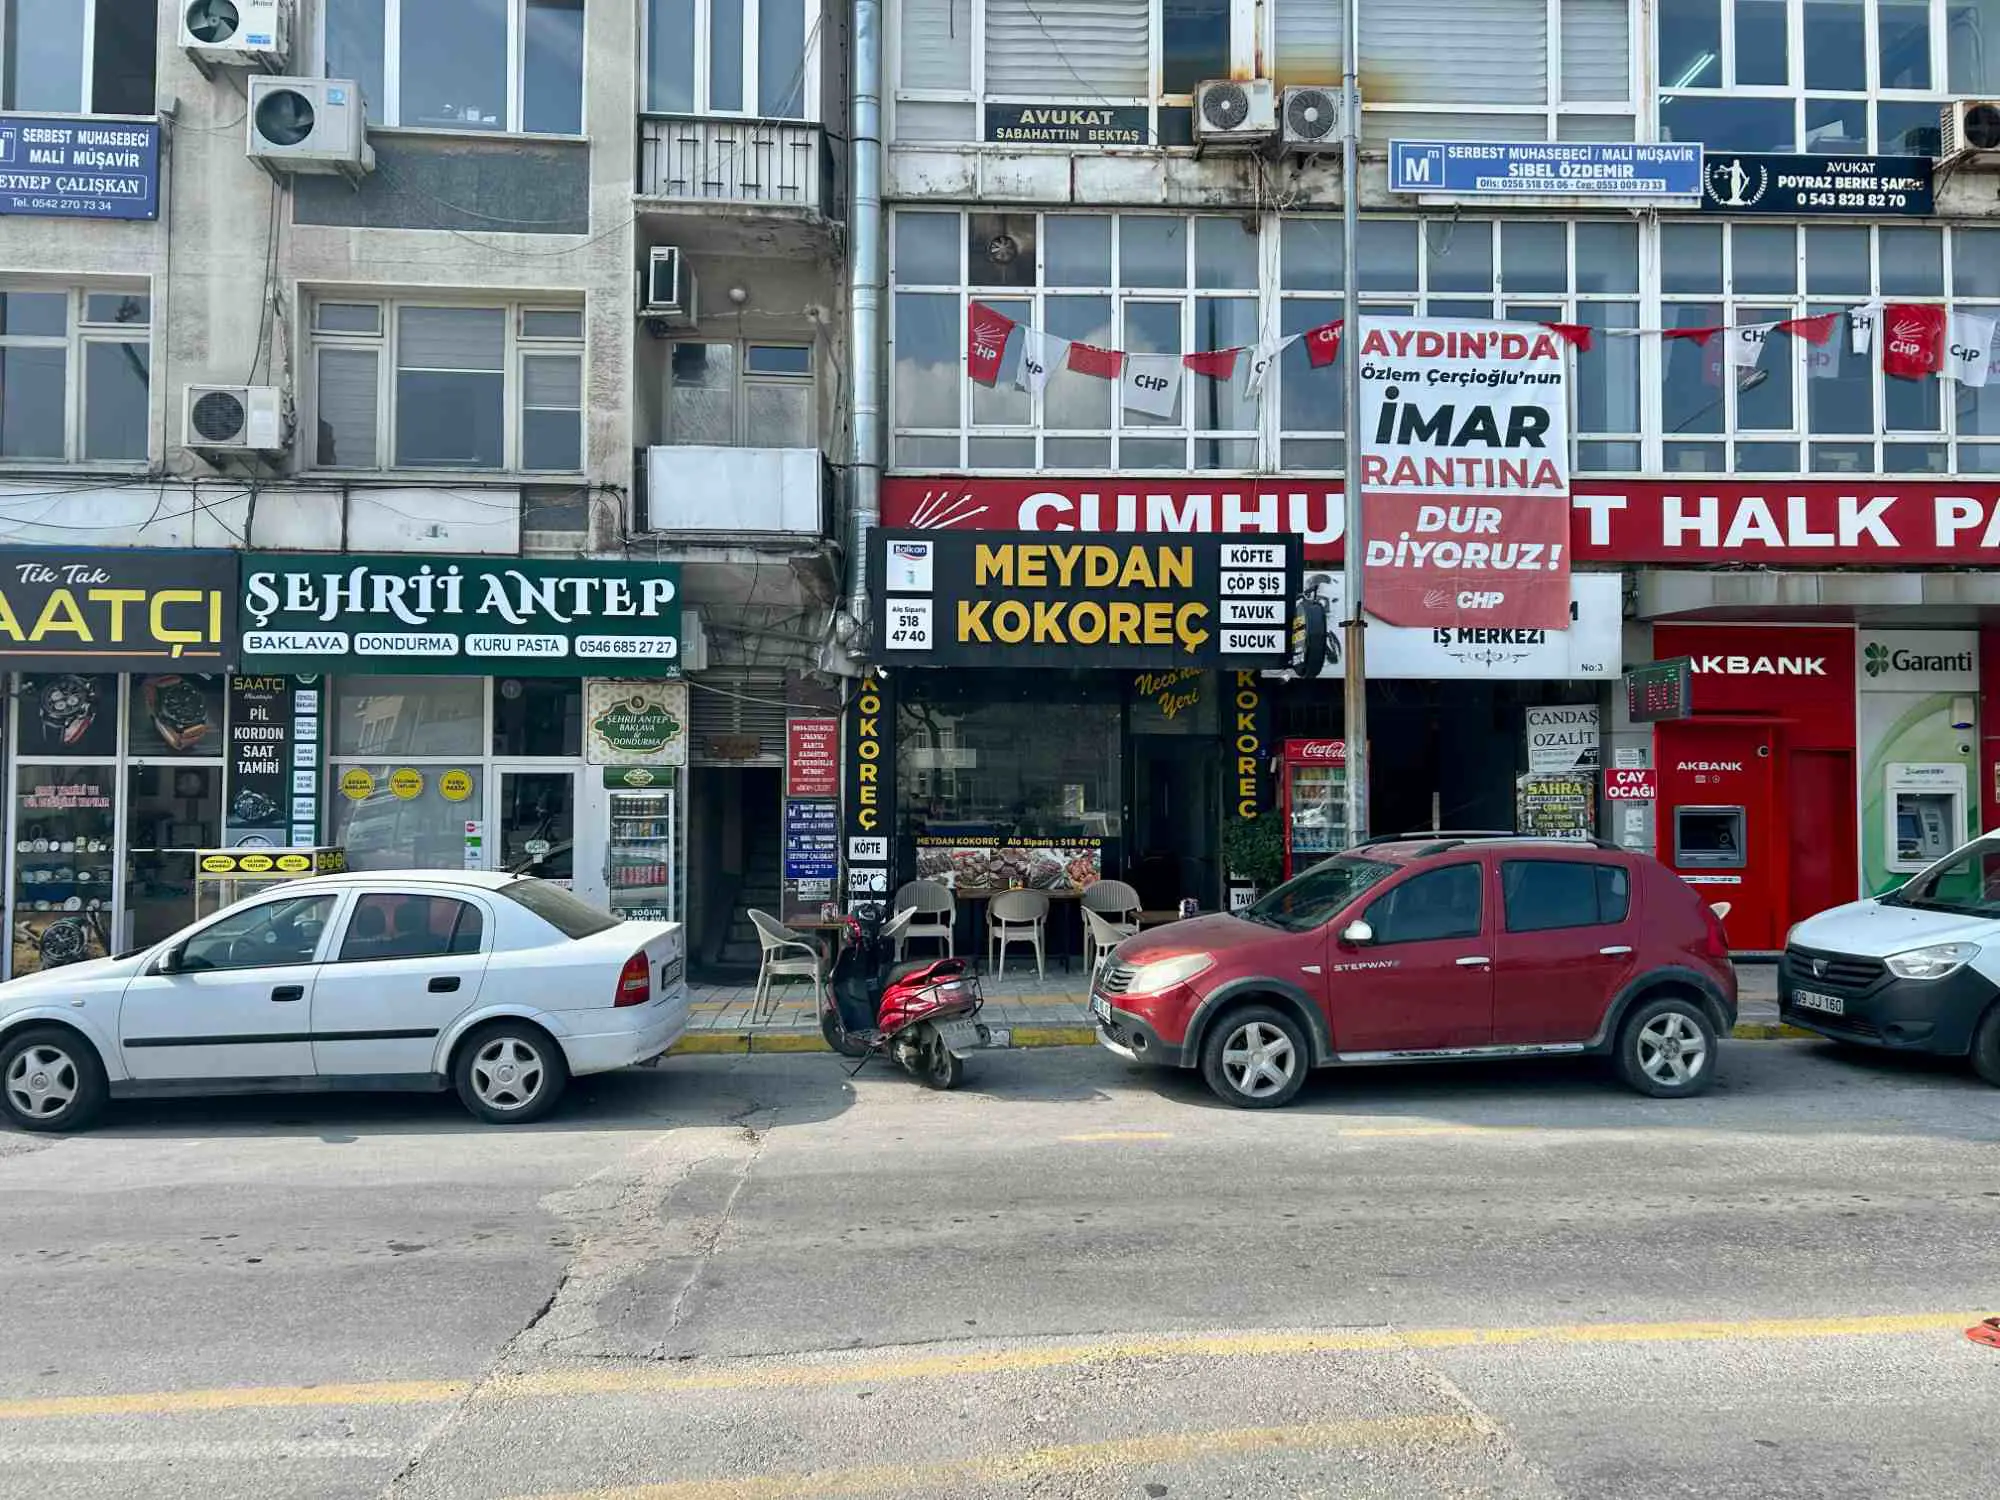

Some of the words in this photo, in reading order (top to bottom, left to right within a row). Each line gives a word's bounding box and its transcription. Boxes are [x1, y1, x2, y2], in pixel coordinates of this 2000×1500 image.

[1020, 109, 1114, 125] AVUKAT
[22, 127, 73, 145] SERBEST
[77, 129, 150, 148] MUHASEBECİ
[1088, 129, 1140, 145] BEKTAŞ
[29, 147, 65, 164] MALİ
[73, 148, 140, 170] MÜŞAVİR
[1448, 146, 1506, 160] SERBEST
[1509, 146, 1592, 161] MUHASEBECİ
[1602, 146, 1633, 161] MALİ
[1636, 146, 1694, 164] MÜŞAVİR
[1826, 162, 1876, 174] AVUKAT
[55, 176, 140, 196] ÇALIŞKAN
[1778, 175, 1833, 189] POYRAZ
[1835, 177, 1878, 190] BERKE
[32, 199, 58, 209] 0542
[60, 200, 81, 209] 270
[83, 201, 96, 210] 73
[99, 201, 112, 211] 34
[1797, 192, 1807, 206] 0
[1809, 193, 1836, 206] 543
[1838, 194, 1865, 207] 828
[1867, 194, 1886, 207] 82
[1887, 195, 1907, 208] 70
[1360, 329, 1560, 361] AYDIN'DA
[1889, 340, 1921, 355] CHP
[1134, 374, 1169, 392] CHP
[1361, 362, 1421, 382] Özlem
[1427, 368, 1562, 388] Çerçioğlu'nun
[1375, 385, 1551, 448] İMAR
[1361, 454, 1565, 490] RANTINA
[1416, 505, 1504, 535] DUR
[1662, 496, 1902, 548] HALK
[1230, 545, 1273, 563] KÖFTE
[1365, 531, 1564, 571] DİYORUZ!
[16, 563, 59, 585] Tik
[62, 563, 111, 585] Tak
[975, 544, 1193, 588] MEYDAN
[1227, 573, 1255, 594] ÇÖP
[1258, 573, 1280, 594] ŞİŞ
[245, 563, 464, 627] ŞEHRİİ
[476, 570, 676, 625] ANTEP
[1456, 591, 1505, 610] CHP
[1230, 605, 1275, 619] TAVUK
[899, 615, 919, 627] 518
[957, 599, 1210, 654] KOKOREÇ
[249, 636, 343, 650] BAKLAVA
[359, 636, 453, 652] DONDURMA
[892, 630, 907, 642] 47
[908, 630, 926, 642] 40
[1229, 634, 1276, 649] SUCUK
[473, 637, 512, 652] KURU
[517, 637, 560, 653] PASTA
[579, 640, 611, 653] 0546
[613, 641, 636, 653] 685
[639, 641, 654, 653] 27
[656, 641, 672, 653] 27
[1892, 649, 1973, 673] Garanti
[233, 677, 285, 693] SAATÇI
[250, 705, 270, 721] PİL
[1528, 710, 1599, 726] CANDAŞ
[234, 727, 284, 740] KORDON
[619, 723, 656, 733] BAKLAVA
[613, 737, 662, 746] DONDURMA
[1533, 730, 1595, 747] OZALİT
[242, 745, 275, 758] SAAT
[237, 759, 280, 774] TAMİRİ
[1676, 761, 1743, 771] AKBANK
[1616, 771, 1646, 785] ÇAY
[1527, 782, 1583, 795] SAHRA
[1608, 783, 1655, 798] OCAĞI
[854, 839, 881, 854] KÖFTE
[916, 837, 955, 846] MEYDAN
[1333, 960, 1393, 972] STEPWAY
